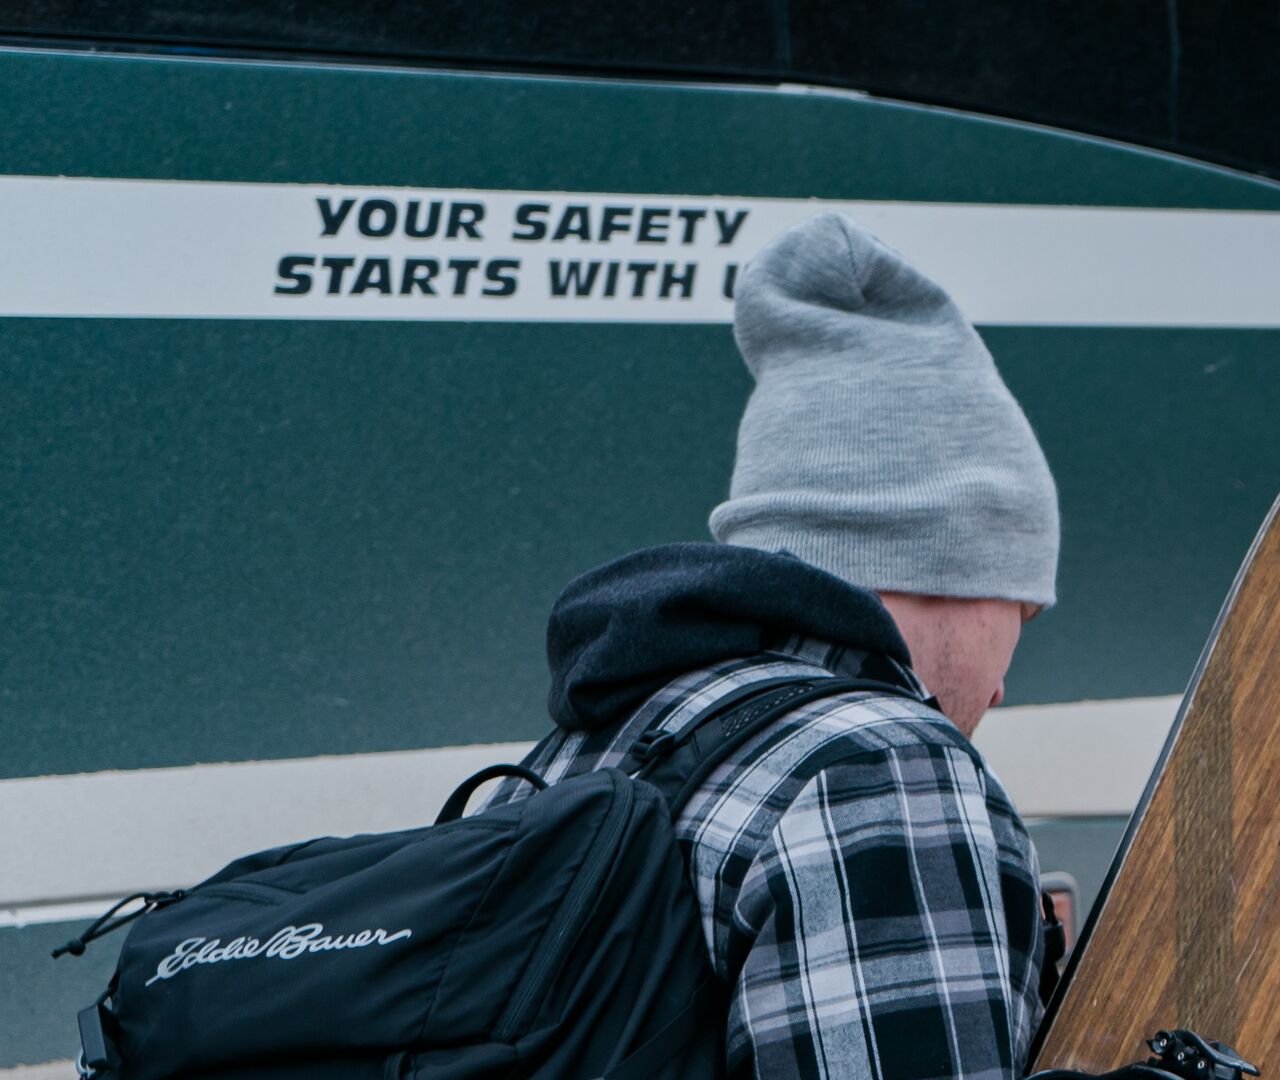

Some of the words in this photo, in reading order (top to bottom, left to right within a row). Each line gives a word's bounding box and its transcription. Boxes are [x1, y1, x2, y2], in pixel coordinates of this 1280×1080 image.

[315, 197, 486, 239] YOUR
[512, 202, 749, 245] SAFETY
[274, 254, 521, 297] STARTS
[549, 259, 697, 298] WITH
[145, 936, 264, 987] Eddie
[265, 922, 412, 960] Bauer
